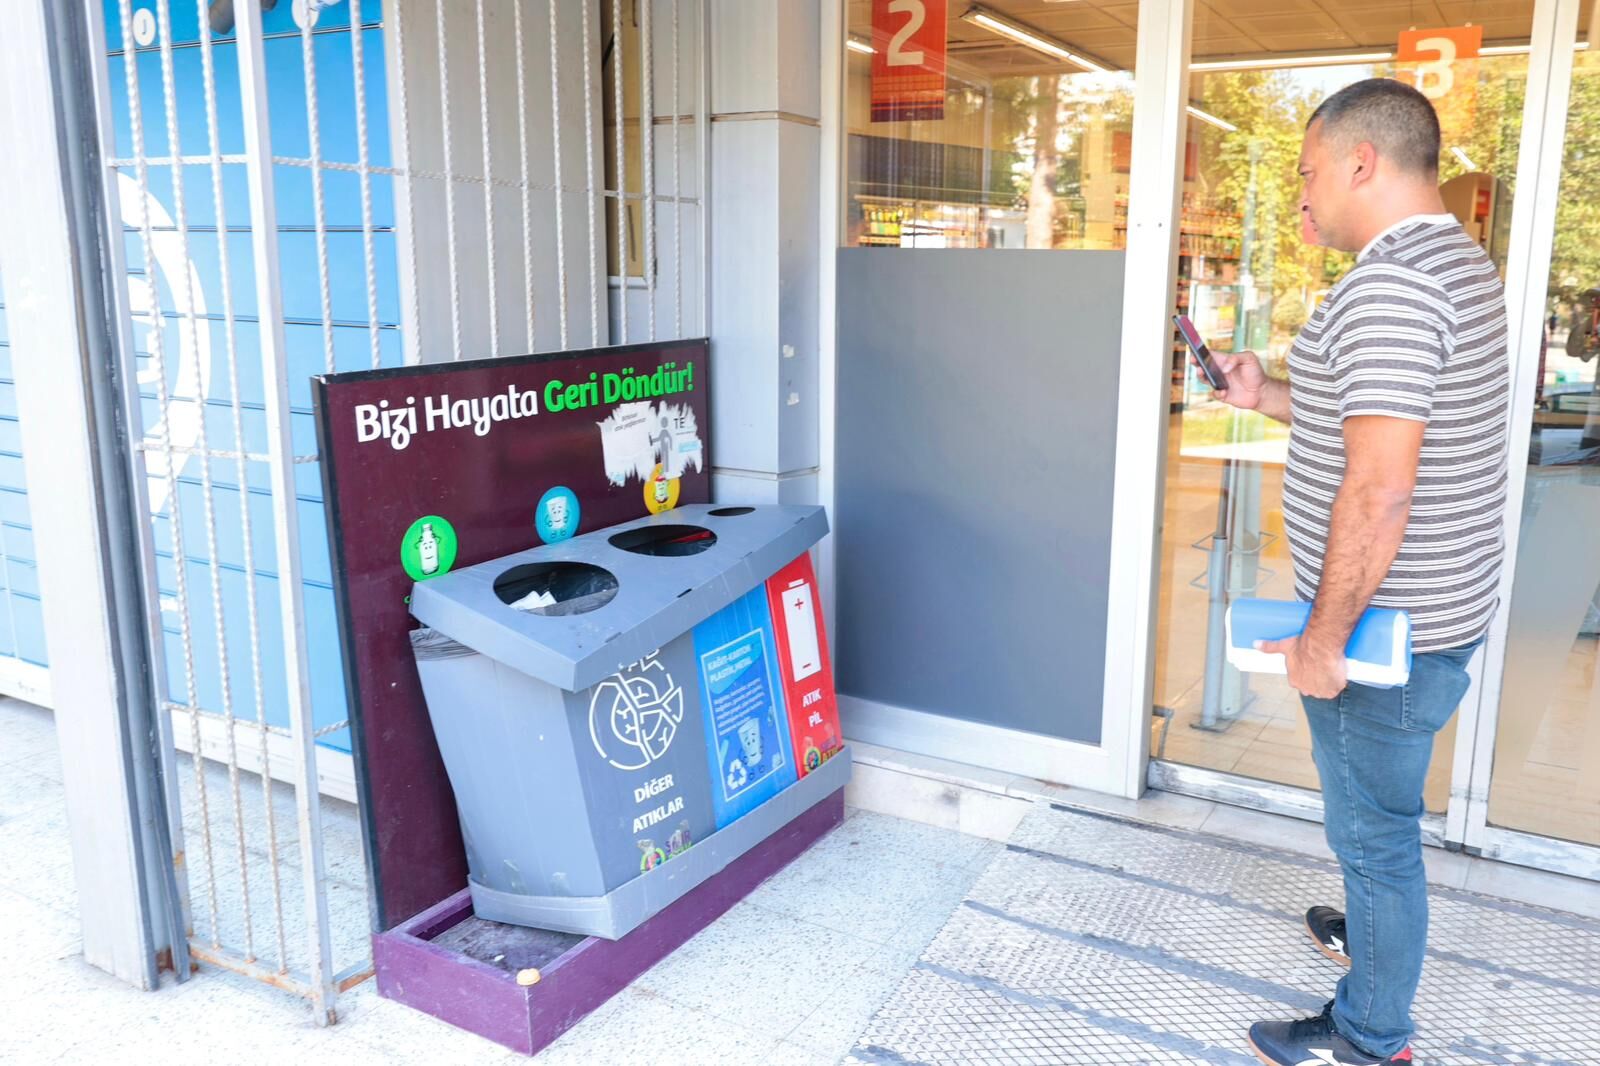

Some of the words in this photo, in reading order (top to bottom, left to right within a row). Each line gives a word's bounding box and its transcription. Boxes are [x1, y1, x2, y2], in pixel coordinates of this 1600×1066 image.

[887, 0, 926, 66] 2
[1415, 37, 1457, 99] 3
[354, 396, 418, 450] Bizi
[425, 384, 539, 437] Hayata
[544, 369, 598, 413] Geri
[602, 362, 695, 404] Döndür!
[802, 688, 822, 708] ATIK
[808, 711, 824, 728] PİL
[633, 773, 675, 803] DİĞER
[632, 797, 684, 833] ATIKLAR
